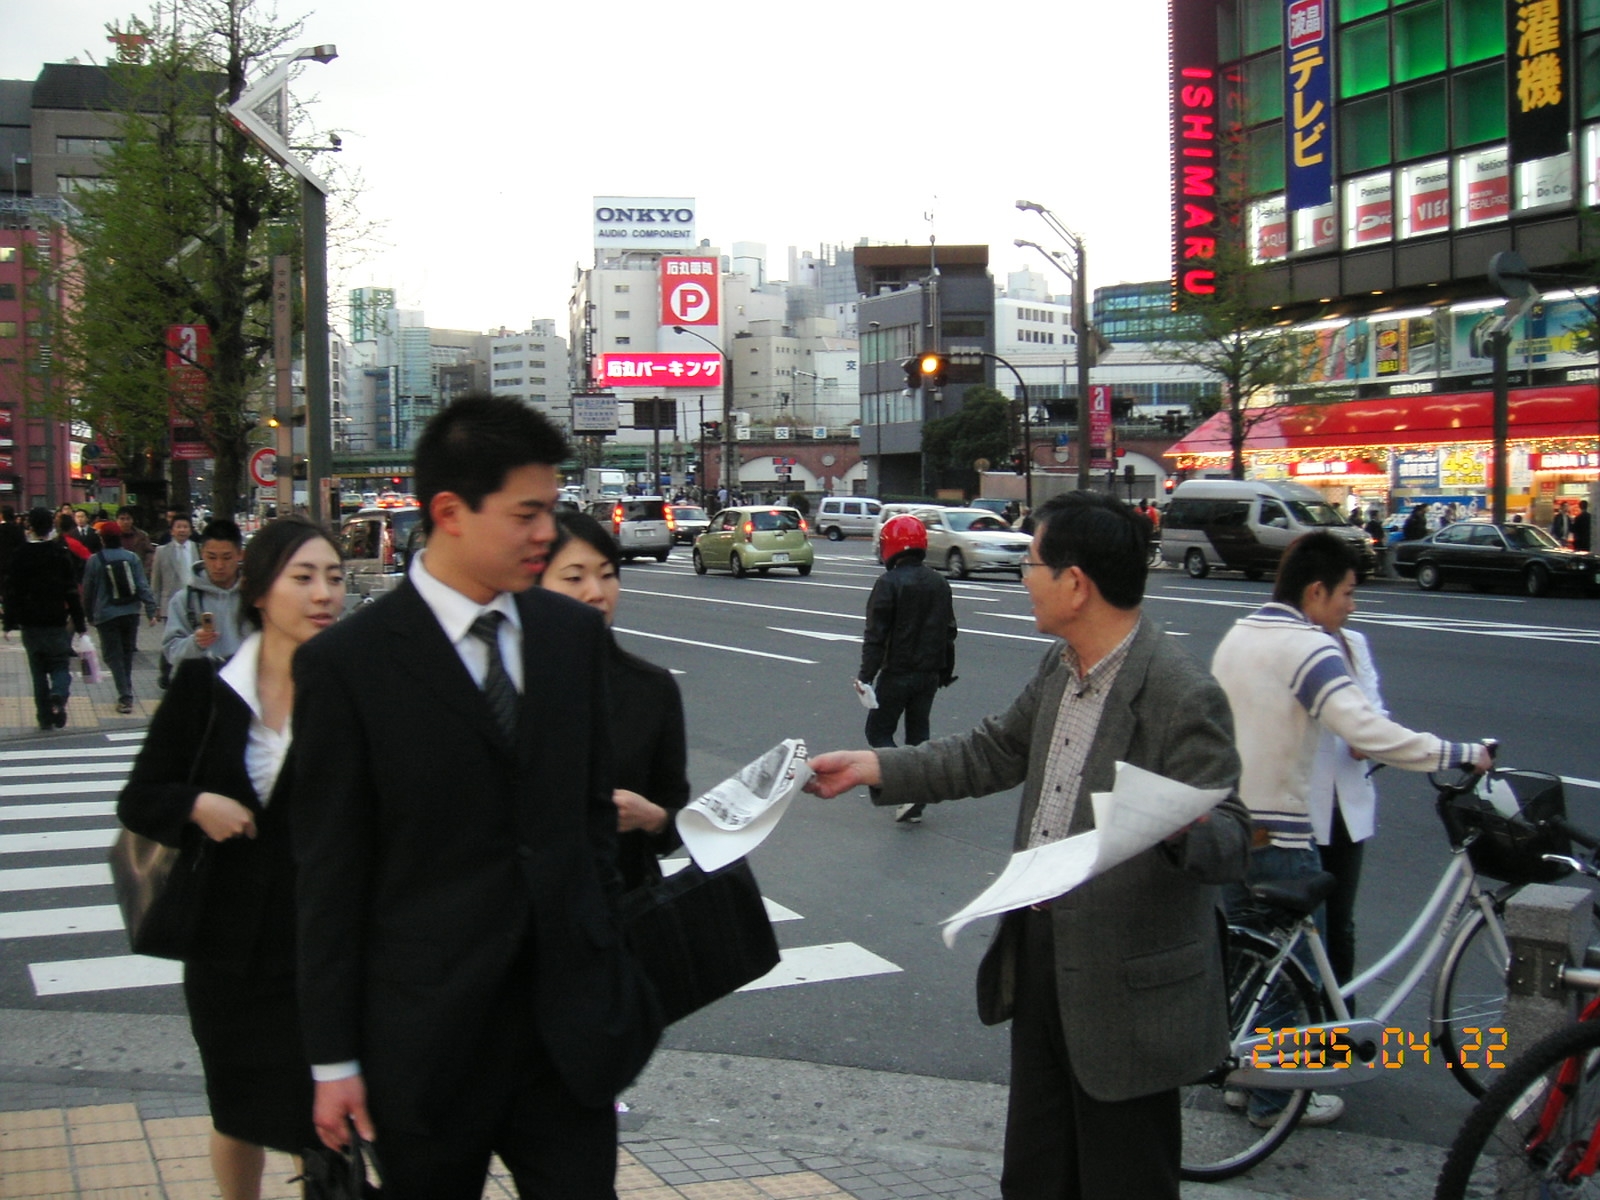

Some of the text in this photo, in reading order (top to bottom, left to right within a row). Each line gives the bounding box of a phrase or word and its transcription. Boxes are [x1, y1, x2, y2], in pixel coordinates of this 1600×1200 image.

[1290, 5, 1320, 39] 液晶
[1516, 0, 1562, 112] 濯機
[1289, 46, 1326, 168] テレビ
[1181, 67, 1216, 294] ISHIMARU
[596, 207, 693, 222] ONKYO
[598, 229, 691, 238] AUDIO COMPONENT
[680, 289, 704, 316] P
[607, 360, 720, 377] 石丸パーキング
